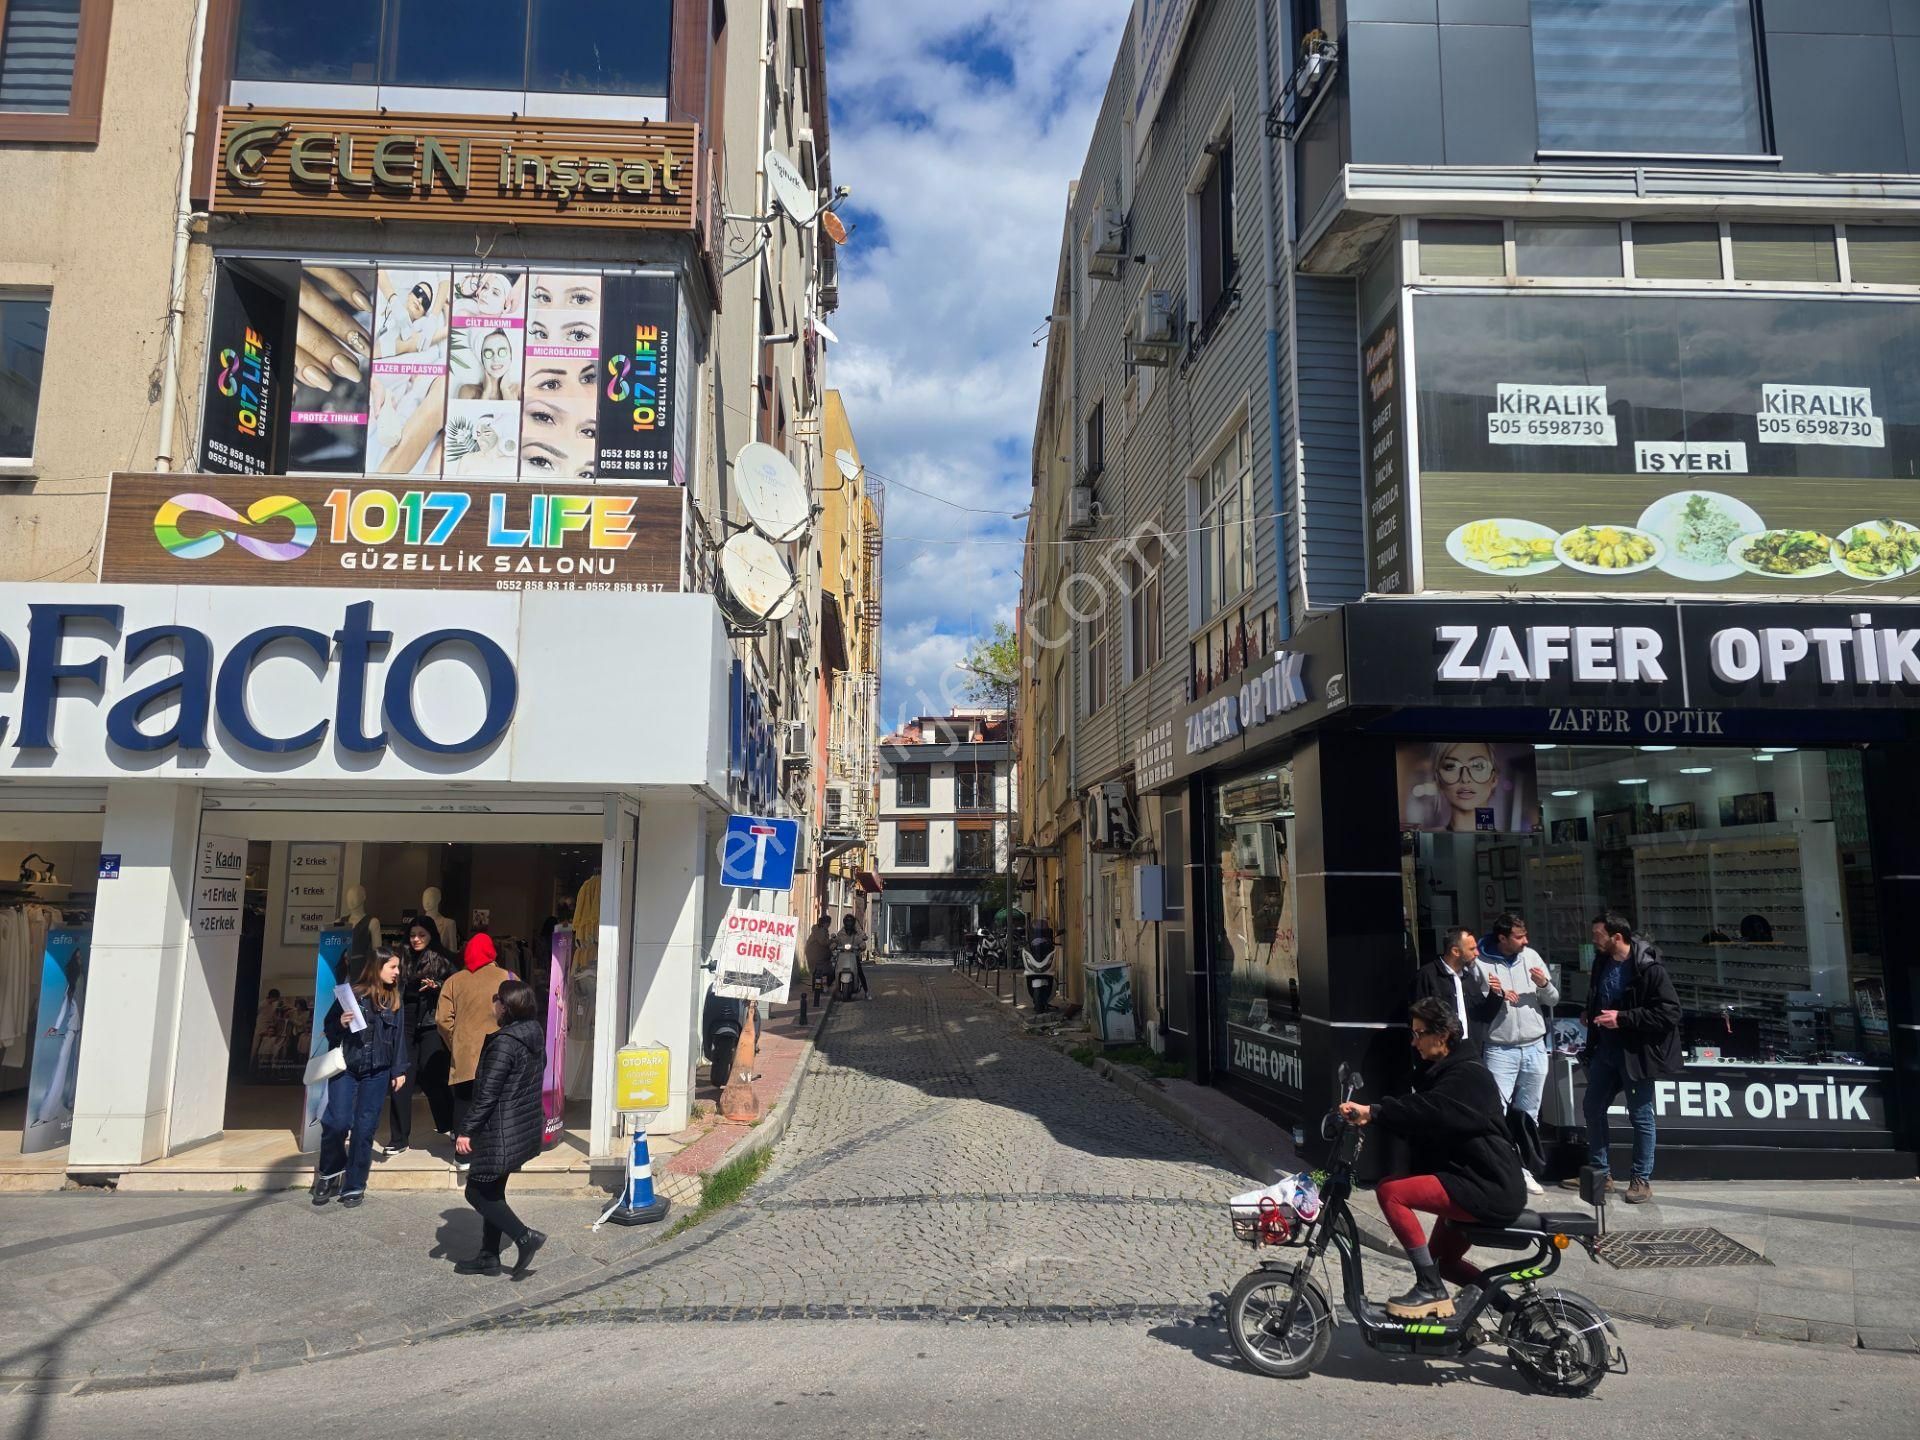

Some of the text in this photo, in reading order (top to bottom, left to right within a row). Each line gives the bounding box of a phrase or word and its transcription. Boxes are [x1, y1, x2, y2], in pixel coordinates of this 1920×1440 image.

[500, 142, 681, 199] inşaat
[604, 205, 624, 215] 286
[630, 206, 648, 216] 213
[650, 207, 663, 216] 21
[666, 207, 681, 217] 00
[465, 316, 512, 328] CİLT BAKIMI
[374, 361, 444, 375] LAZER EPİLASYON
[633, 324, 658, 432] 1017 LIFE
[657, 330, 669, 427] GÜZELLİK SALONU
[237, 325, 264, 437] 1017 LIFE
[1499, 388, 1603, 416] KİRALIK
[1765, 388, 1866, 417] KİRALIK
[297, 412, 359, 424] PROTEZ TIRNAK
[1488, 417, 1604, 436] 505 6598730
[1758, 416, 1873, 437] 505 6598730
[208, 451, 228, 466] 0552
[228, 458, 243, 473] 858
[209, 439, 266, 470] 0552 858 93 18
[600, 460, 668, 471] 0552 858 93 17
[601, 449, 668, 460] 0552 858 93 18
[323, 488, 639, 551] 1017 LIFE
[339, 548, 616, 575] GÜZELLİK SALONU
[496, 580, 522, 590] 0552
[524, 580, 544, 591] 858
[546, 581, 559, 591] 93
[562, 581, 575, 591] 18
[585, 581, 609, 591] 0552
[614, 582, 632, 592] 858
[636, 583, 648, 592] 93
[651, 583, 664, 592] 17
[1435, 612, 1920, 685] ZAFER OPTİK
[0, 599, 518, 754] Facto
[1184, 695, 1240, 755] ZAFER
[1239, 650, 1308, 728] OPTİK
[1548, 707, 1724, 735] ZAFER OPTİK
[215, 851, 242, 868] Kadın
[305, 857, 327, 866] Erkek
[303, 887, 325, 895] Erkek
[728, 916, 796, 938] OTOPARK
[736, 940, 781, 963] GİRİŞİ
[622, 1056, 664, 1067] OTOPARK
[1233, 1038, 1268, 1077] ZAFER
[1744, 1075, 1871, 1121] OPTİK
